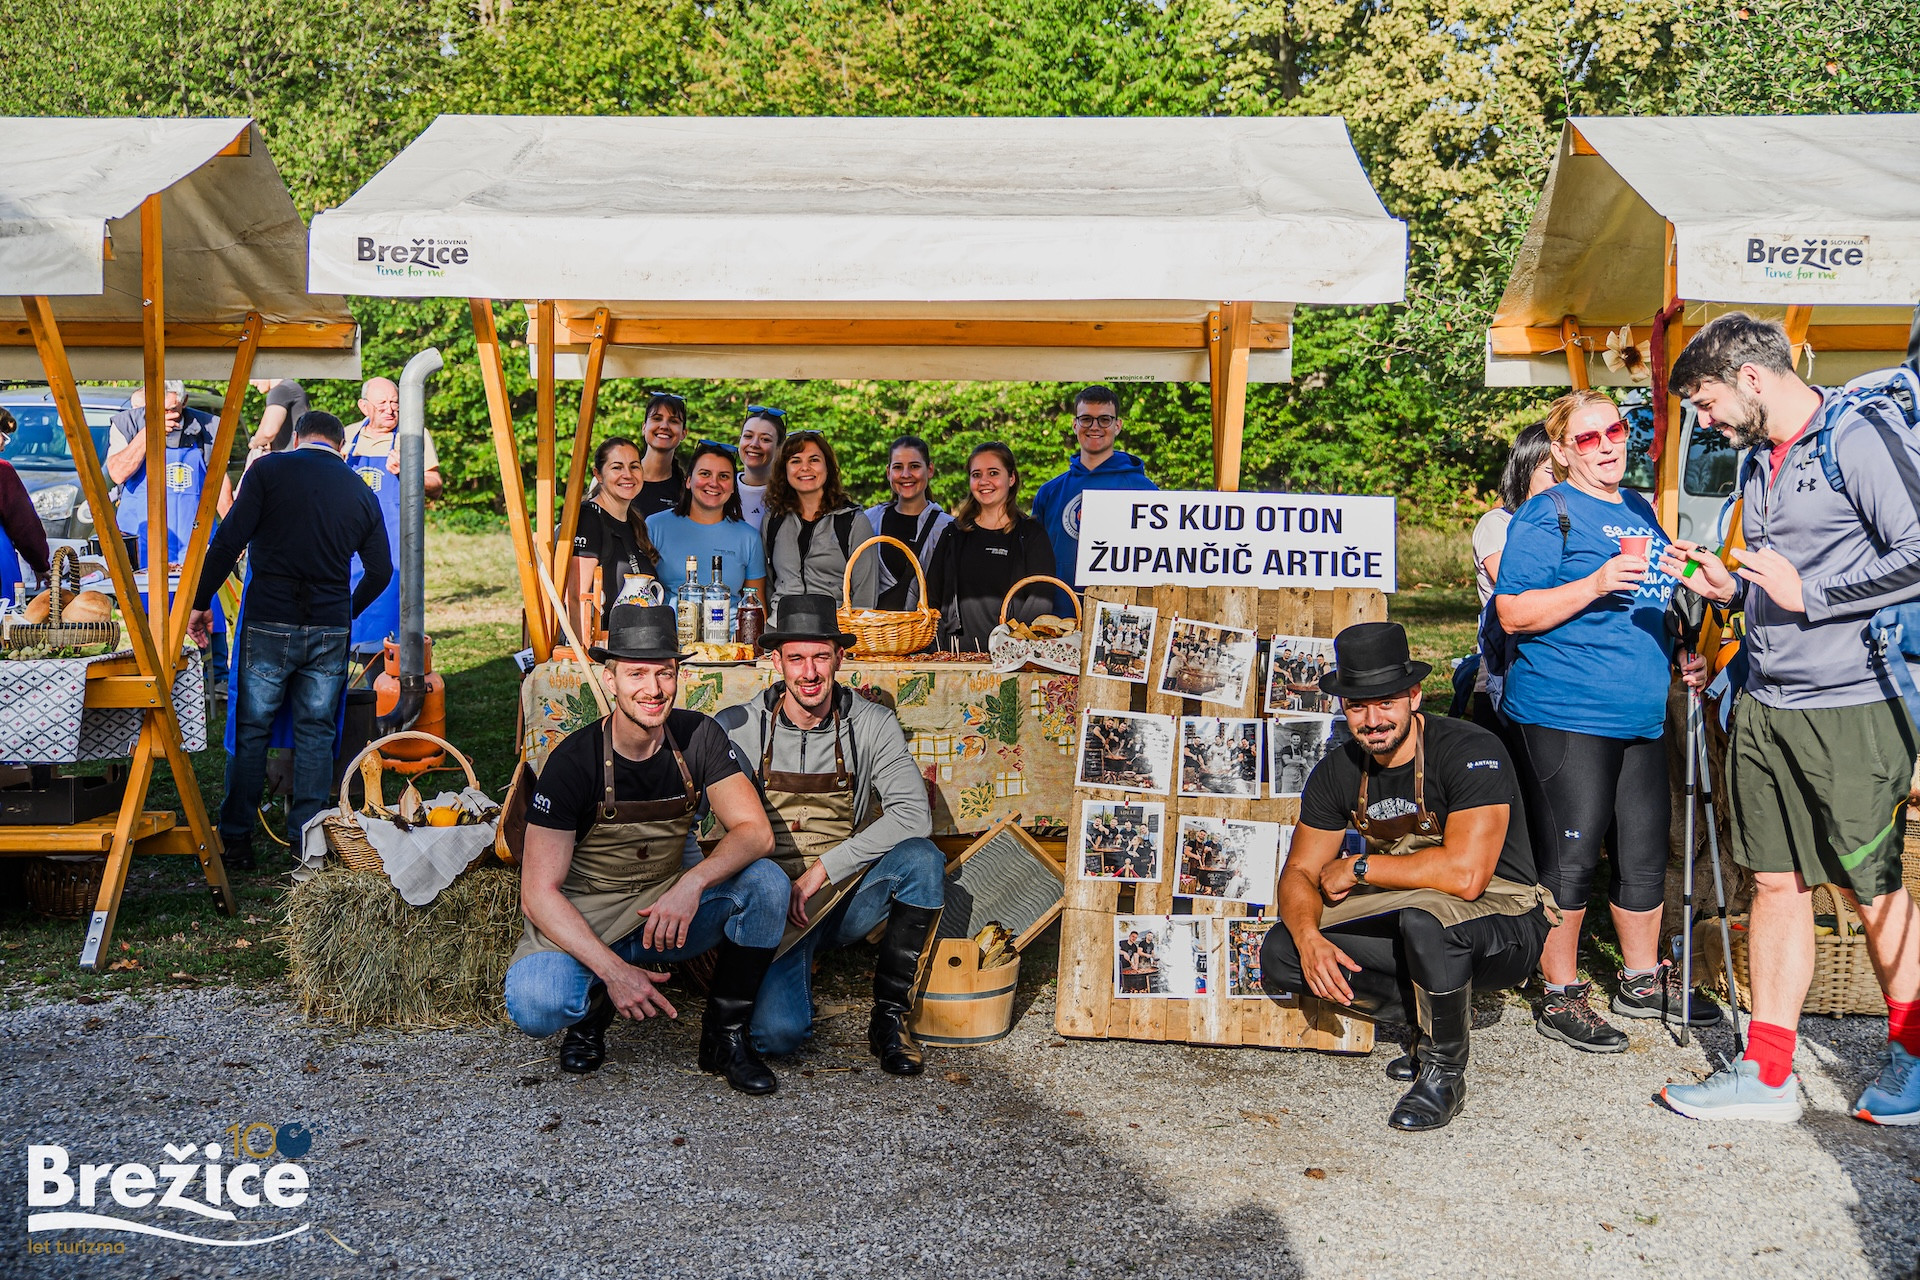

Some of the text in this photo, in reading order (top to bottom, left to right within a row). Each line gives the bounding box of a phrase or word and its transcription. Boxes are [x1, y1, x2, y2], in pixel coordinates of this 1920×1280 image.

[358, 237, 469, 269] Brežice
[1747, 238, 1863, 271] Brežice
[375, 264, 446, 278] Time for me
[1764, 266, 1838, 281] Time for me
[1131, 503, 1342, 533] FS KUD OTON
[1088, 540, 1382, 578] ŽUPANČIČ ARTIČE
